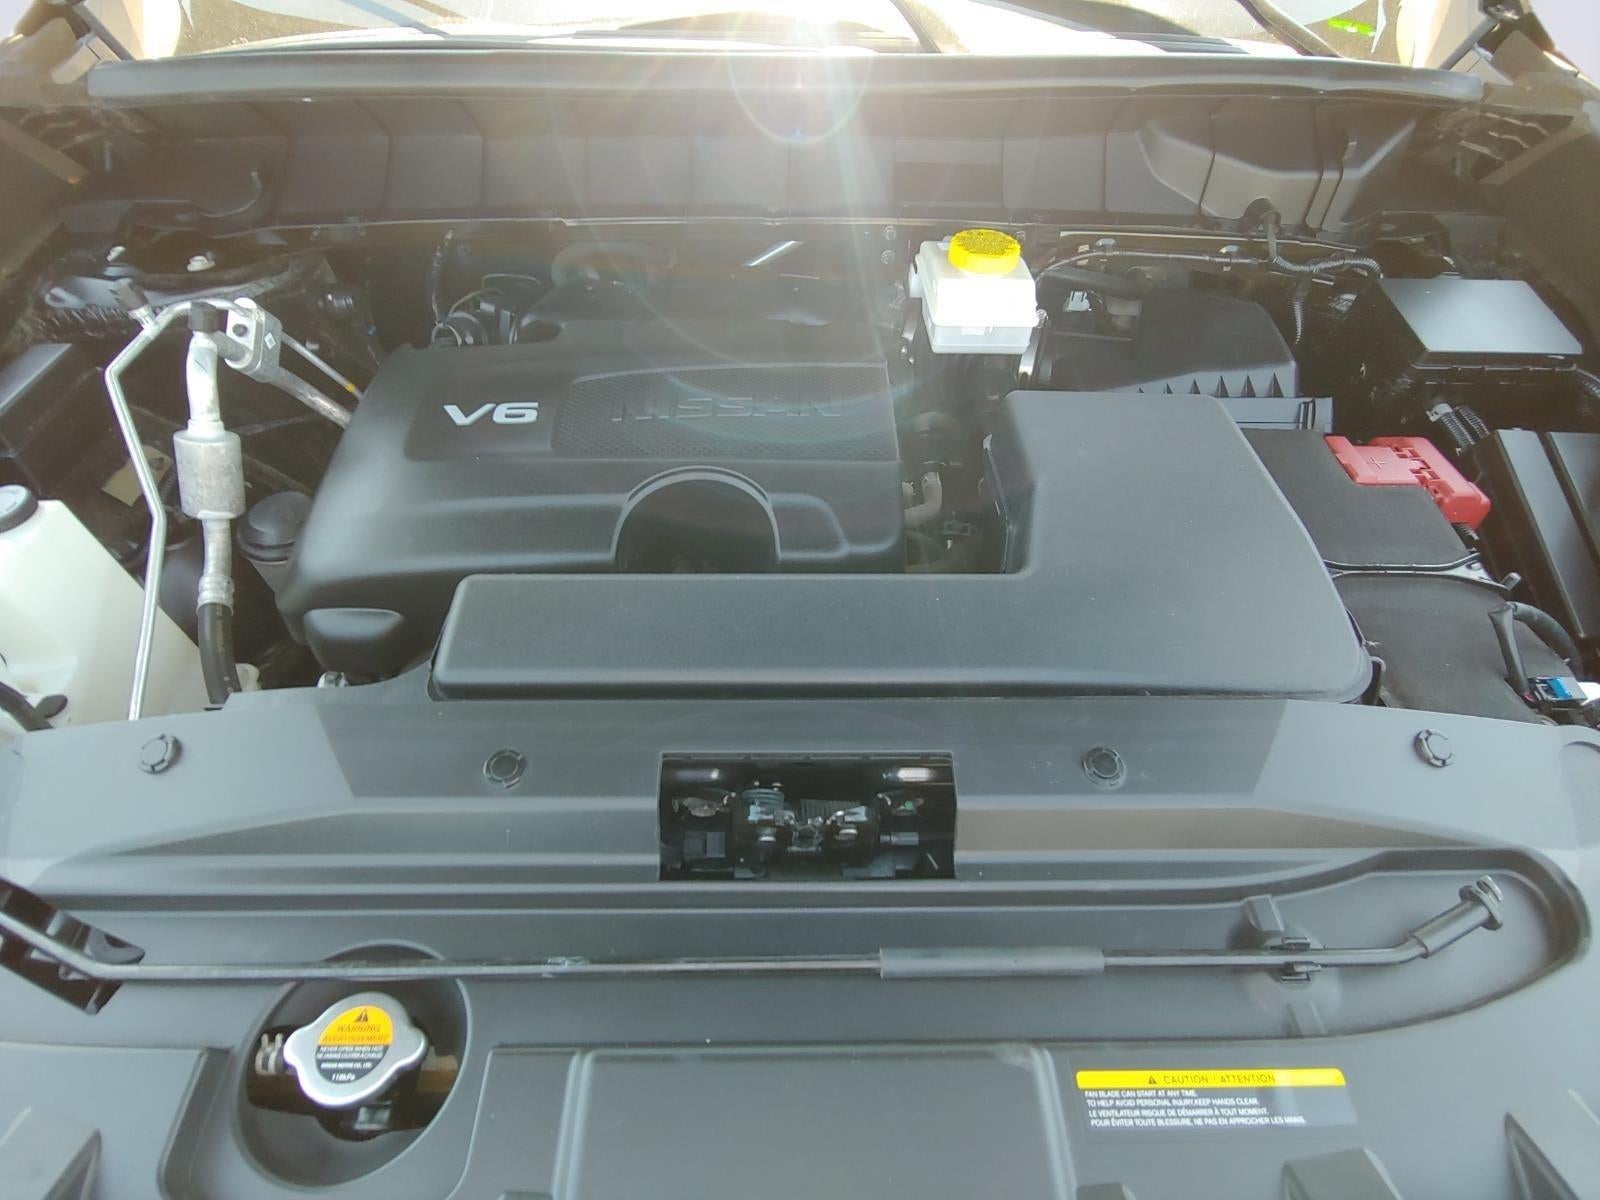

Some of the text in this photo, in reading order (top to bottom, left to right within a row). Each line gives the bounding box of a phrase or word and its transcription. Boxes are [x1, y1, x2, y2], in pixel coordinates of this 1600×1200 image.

[443, 402, 539, 426] V6
[337, 1024, 381, 1033] WARNING
[321, 1034, 389, 1042] AVERTISSEMENT
[1163, 1075, 1208, 1084] CAUTION
[1220, 1074, 1275, 1083] ATTENTION
[1085, 1090, 1098, 1098] FAN
[1099, 1090, 1120, 1098] BLADE
[1121, 1090, 1136, 1098] CAN
[1137, 1089, 1157, 1097] START
[1158, 1089, 1166, 1097] AT
[1167, 1089, 1180, 1097] ANY
[1087, 1099, 1096, 1107] TO
[1097, 1099, 1114, 1107] HELP
[1115, 1099, 1136, 1107] AVOID
[1136, 1098, 1171, 1106] PERSONAL
[1212, 1097, 1236, 1105] HANDS
[1089, 1109, 1098, 1118] LE
[1098, 1109, 1140, 1118] VENTILATEUR
[1141, 1109, 1166, 1117] RISQUE
[1168, 1108, 1177, 1117] DE
[1220, 1108, 1238, 1116] TOUT
[1091, 1118, 1110, 1126] POUR
[1135, 1118, 1156, 1126] TOUTE
[1194, 1117, 1203, 1125] NE
[1205, 1117, 1218, 1125] PAS
[1219, 1117, 1228, 1125] EN
[1229, 1117, 1270, 1125] APPROCHER
[1271, 1116, 1284, 1124] LES
